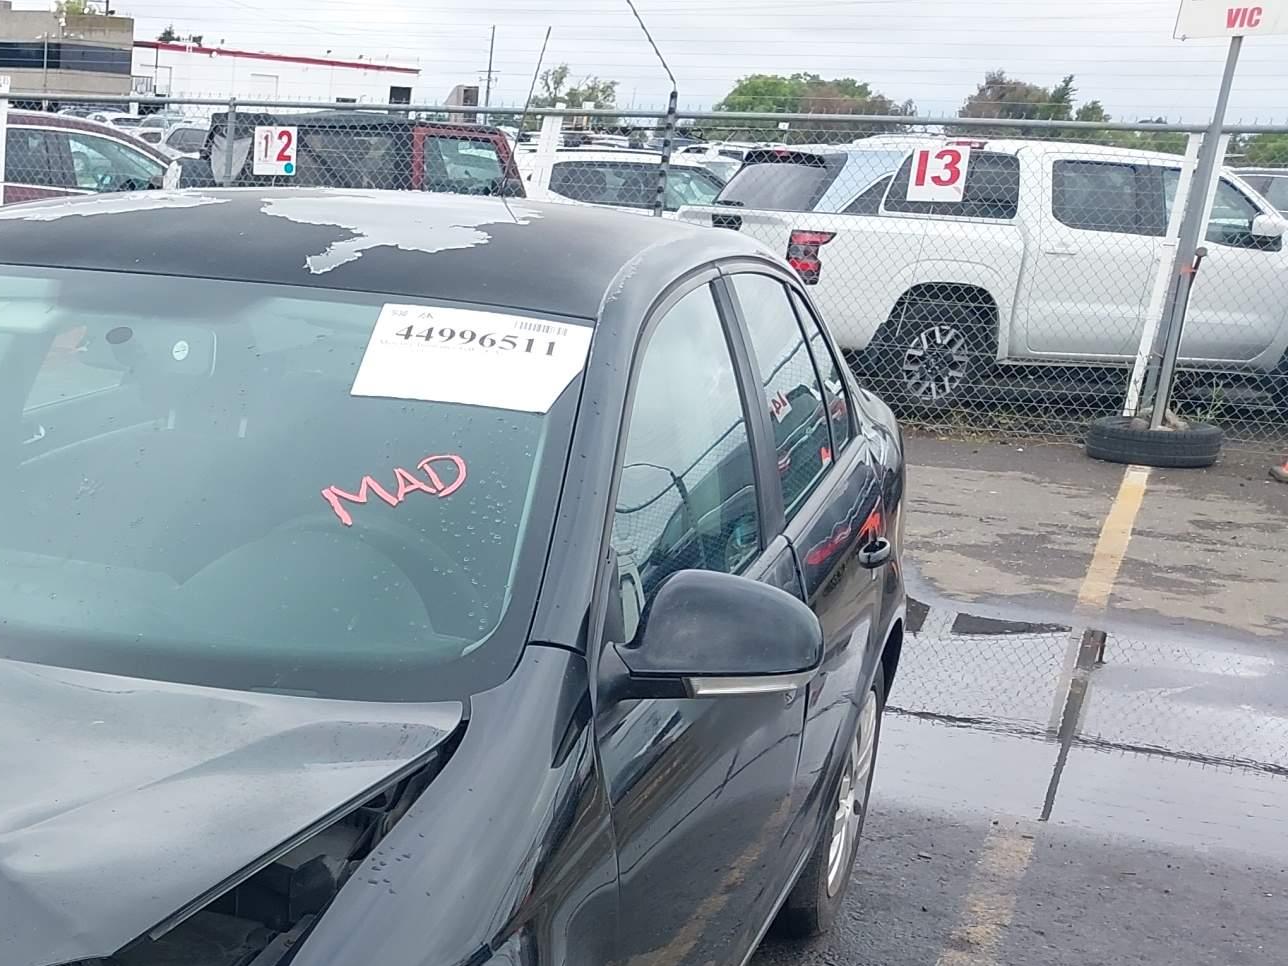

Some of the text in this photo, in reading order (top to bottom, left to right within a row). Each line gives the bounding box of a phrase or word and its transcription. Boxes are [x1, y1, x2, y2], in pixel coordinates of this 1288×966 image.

[1226, 6, 1263, 29] VIC
[263, 130, 292, 161] 12
[915, 149, 962, 186] 13
[395, 324, 556, 356] 44996511
[321, 454, 467, 526] MAD
